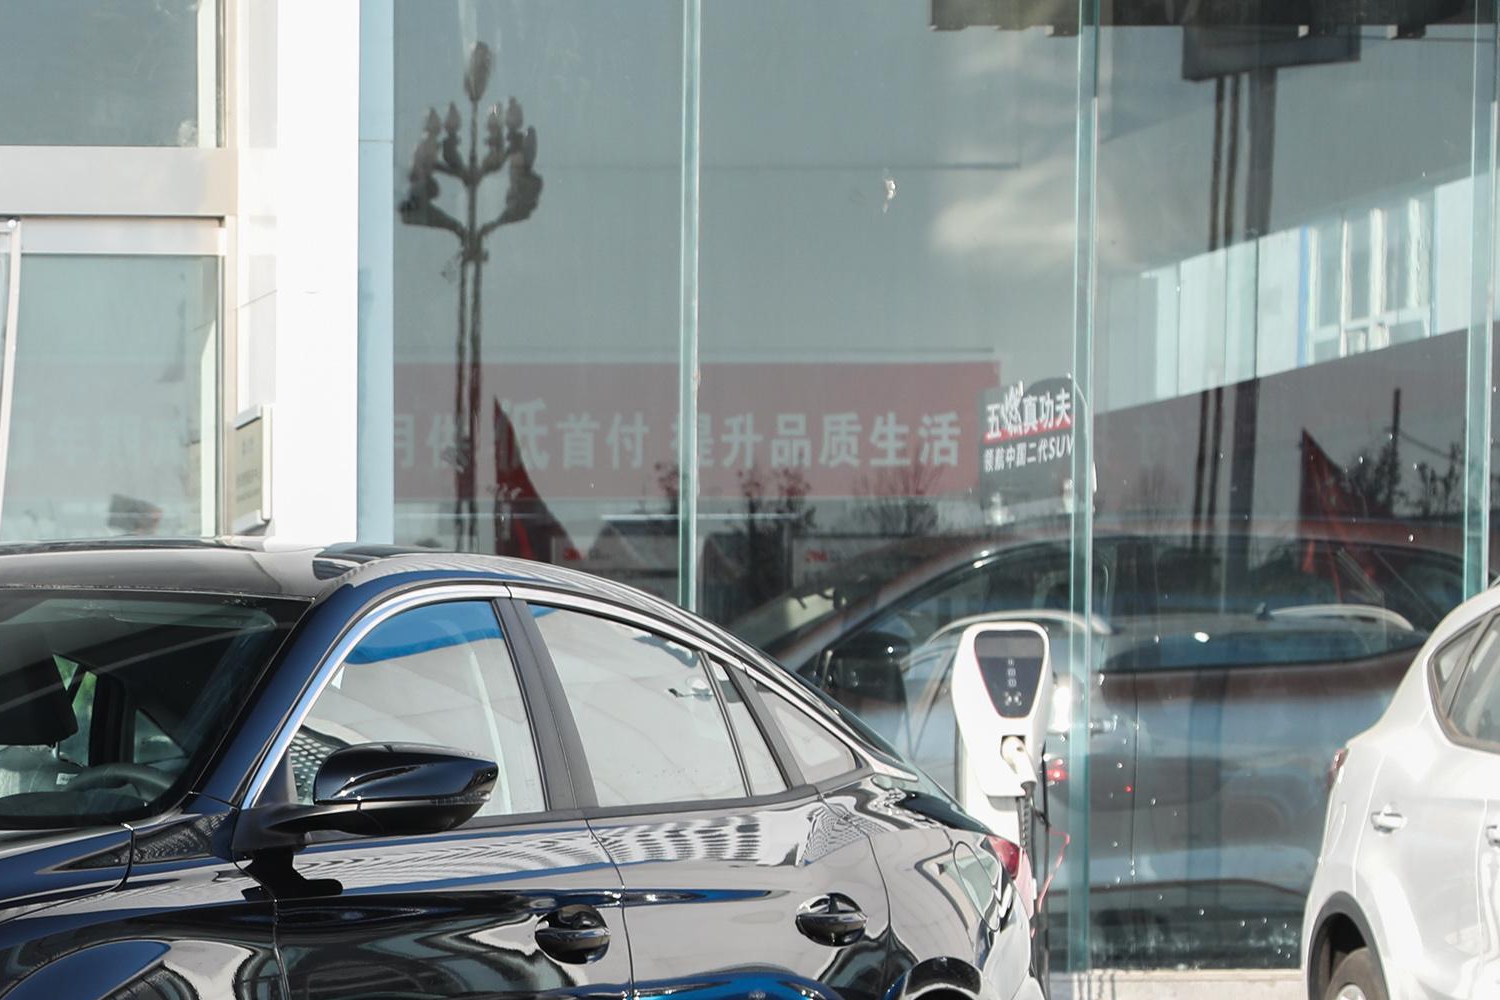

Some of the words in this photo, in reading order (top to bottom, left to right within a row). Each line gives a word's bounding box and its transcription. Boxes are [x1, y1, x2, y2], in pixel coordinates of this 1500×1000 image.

[670, 412, 962, 468] 提升品质生活
